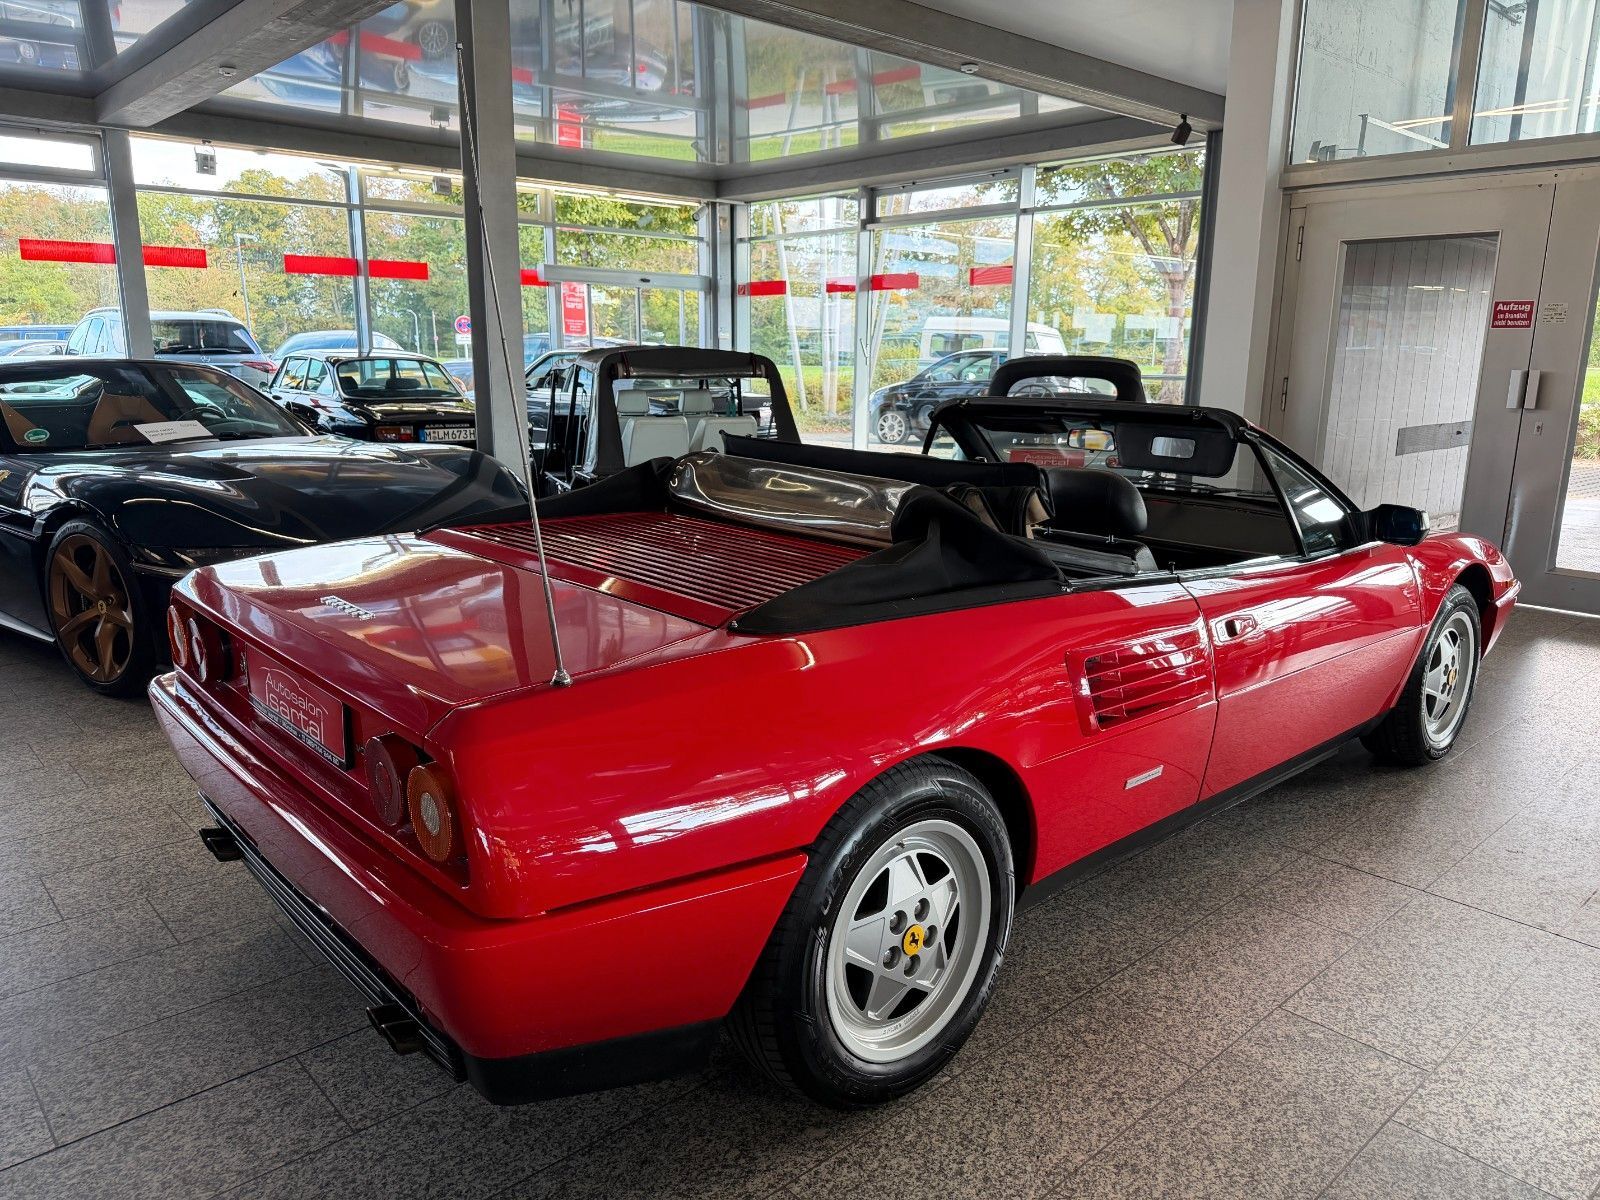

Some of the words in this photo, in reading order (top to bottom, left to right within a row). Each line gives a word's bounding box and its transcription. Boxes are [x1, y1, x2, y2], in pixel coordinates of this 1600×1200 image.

[1496, 302, 1531, 312] Aufzug
[425, 431, 432, 440] M
[265, 672, 323, 717] Autosalon
